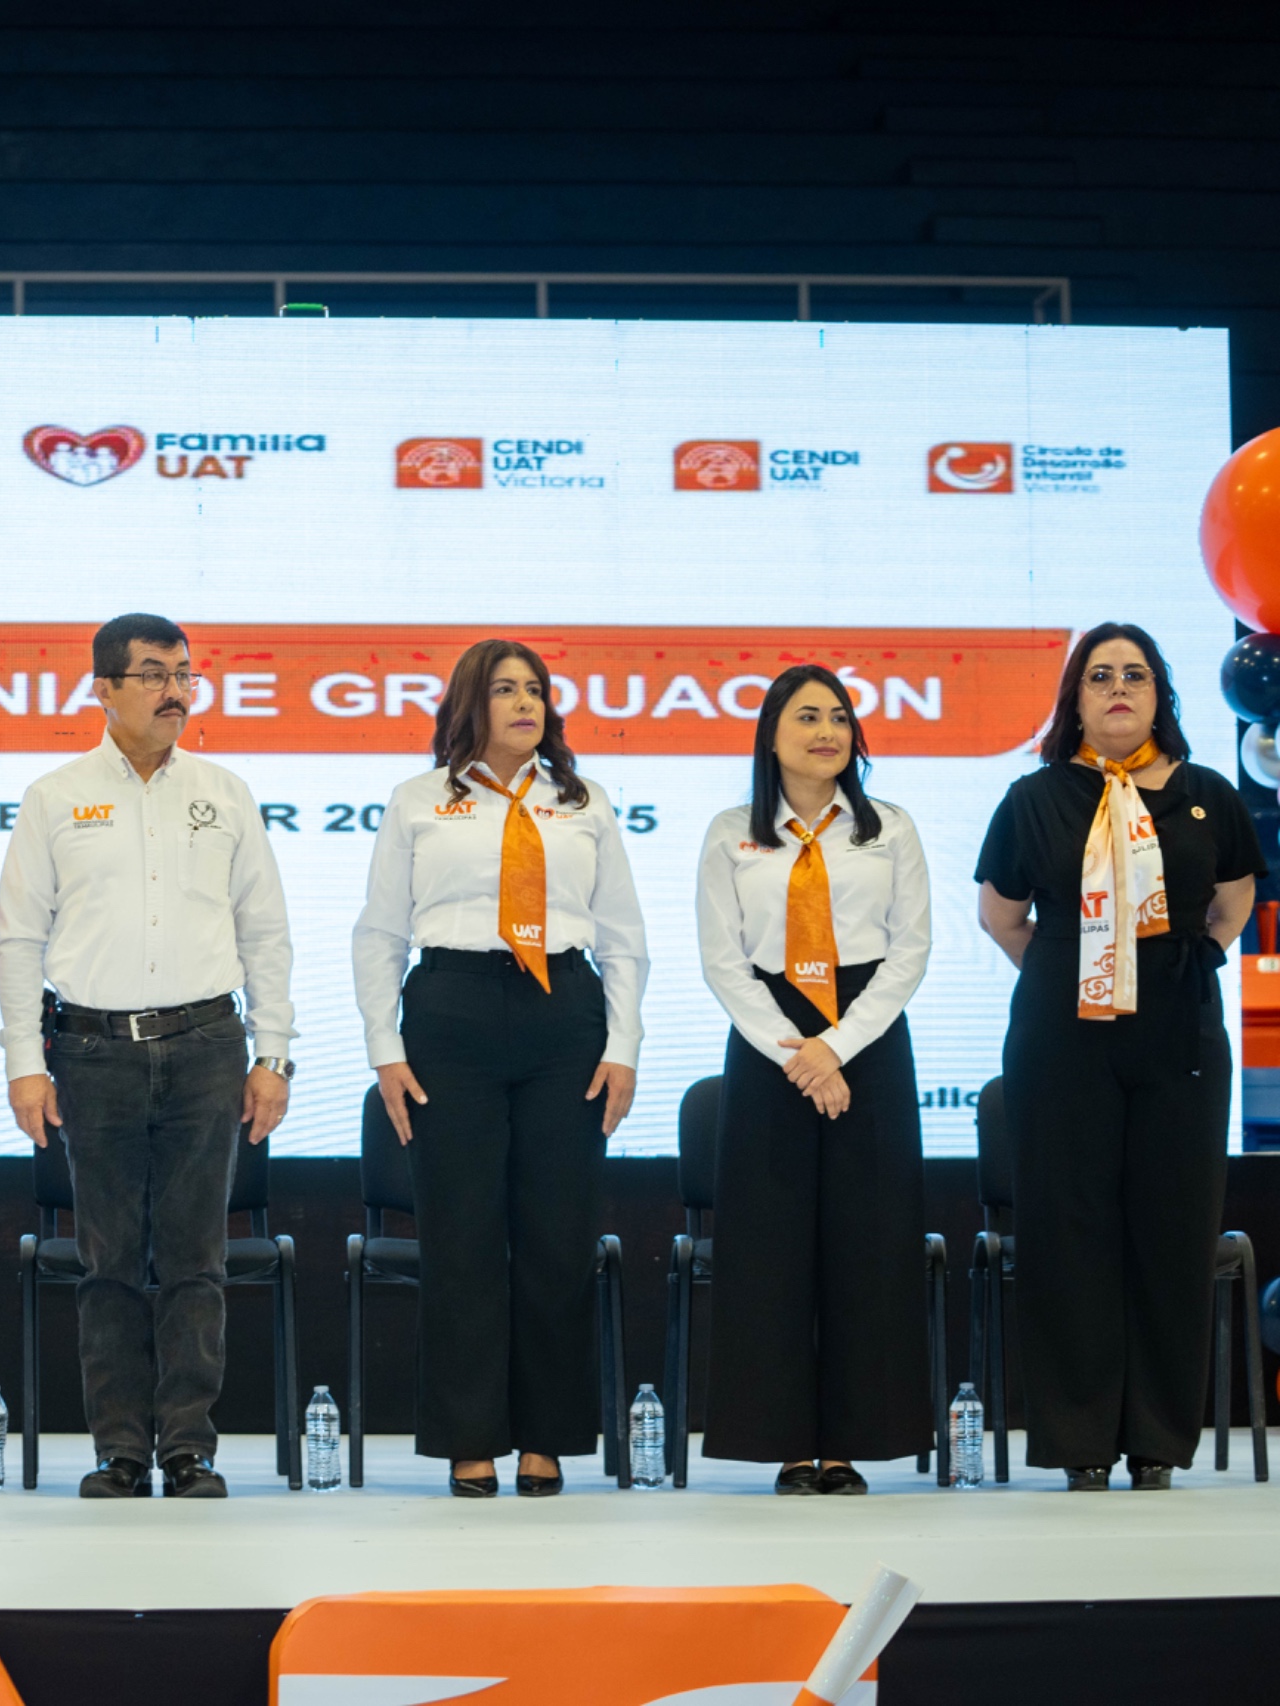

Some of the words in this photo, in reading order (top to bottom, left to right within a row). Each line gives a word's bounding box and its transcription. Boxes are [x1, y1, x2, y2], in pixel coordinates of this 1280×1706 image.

[155, 433, 327, 451] Familia
[493, 439, 584, 455] CENDI
[770, 450, 860, 465] CENDI
[1098, 446, 1124, 457] de
[155, 455, 253, 479] UAT
[493, 456, 546, 471] UAT
[1023, 457, 1127, 469] Desarrollo
[494, 472, 604, 488] Victoria
[770, 467, 823, 481] UAT
[1023, 470, 1093, 481] Infantil
[310, 666, 941, 720] GRUACÓN
[73, 804, 115, 820] UAT
[434, 801, 477, 815] UAT
[512, 923, 542, 939] UAT
[795, 961, 829, 977] UAT
